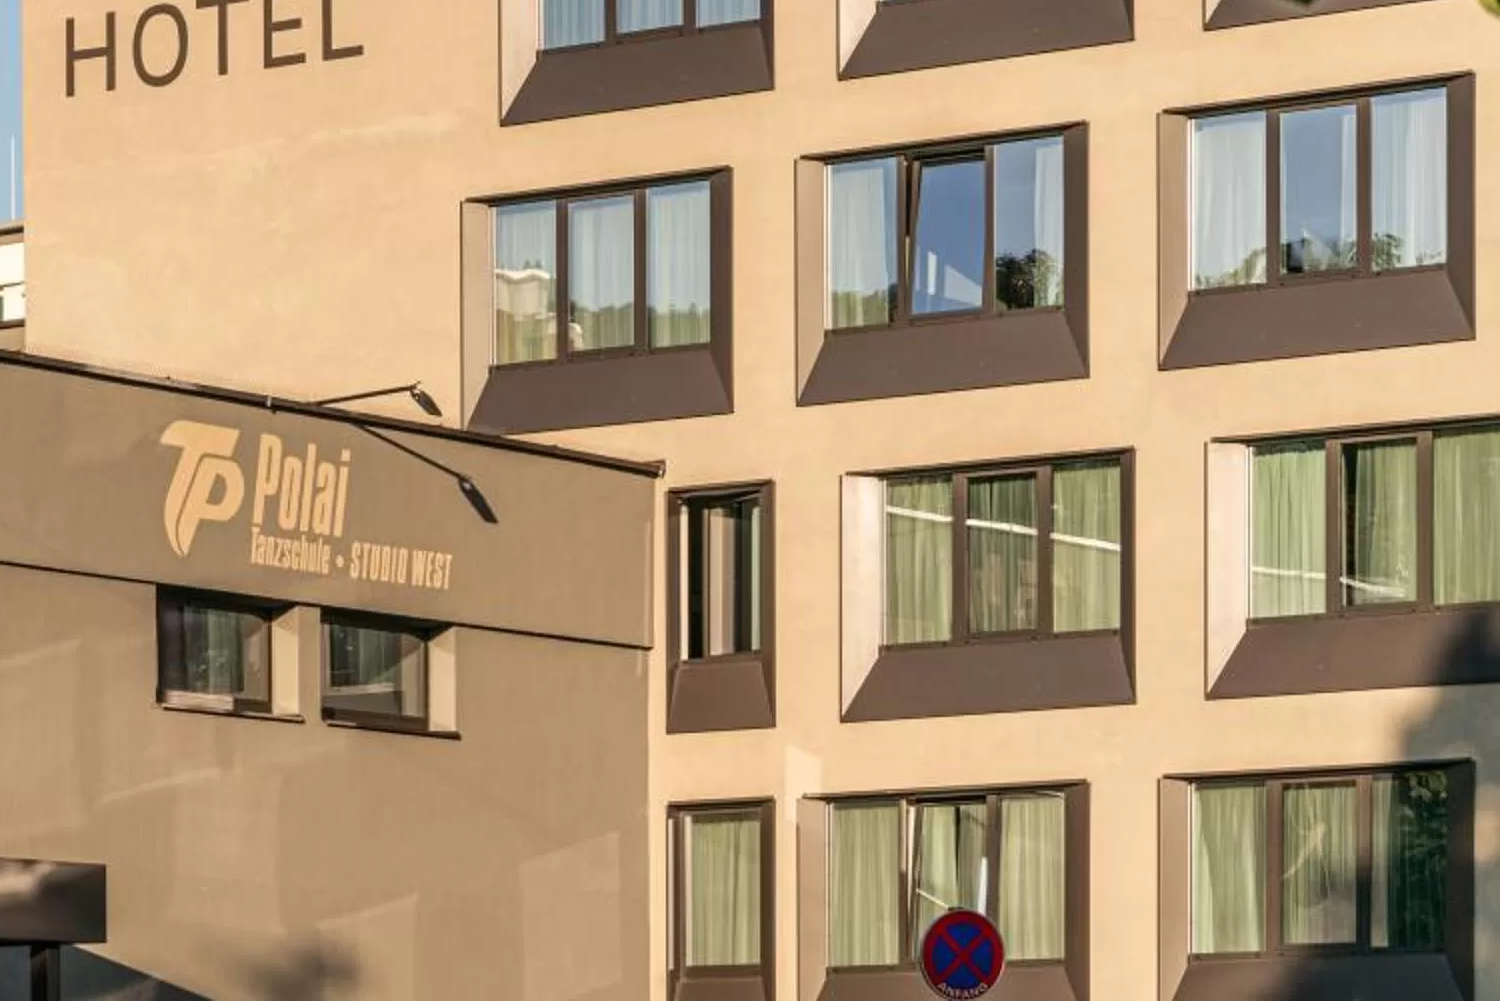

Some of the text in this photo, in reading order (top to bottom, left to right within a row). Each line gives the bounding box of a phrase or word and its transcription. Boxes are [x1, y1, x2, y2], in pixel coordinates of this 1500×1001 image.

[252, 434, 352, 538] Polai
[250, 526, 452, 590] Tanzschule STUDIO WEST
